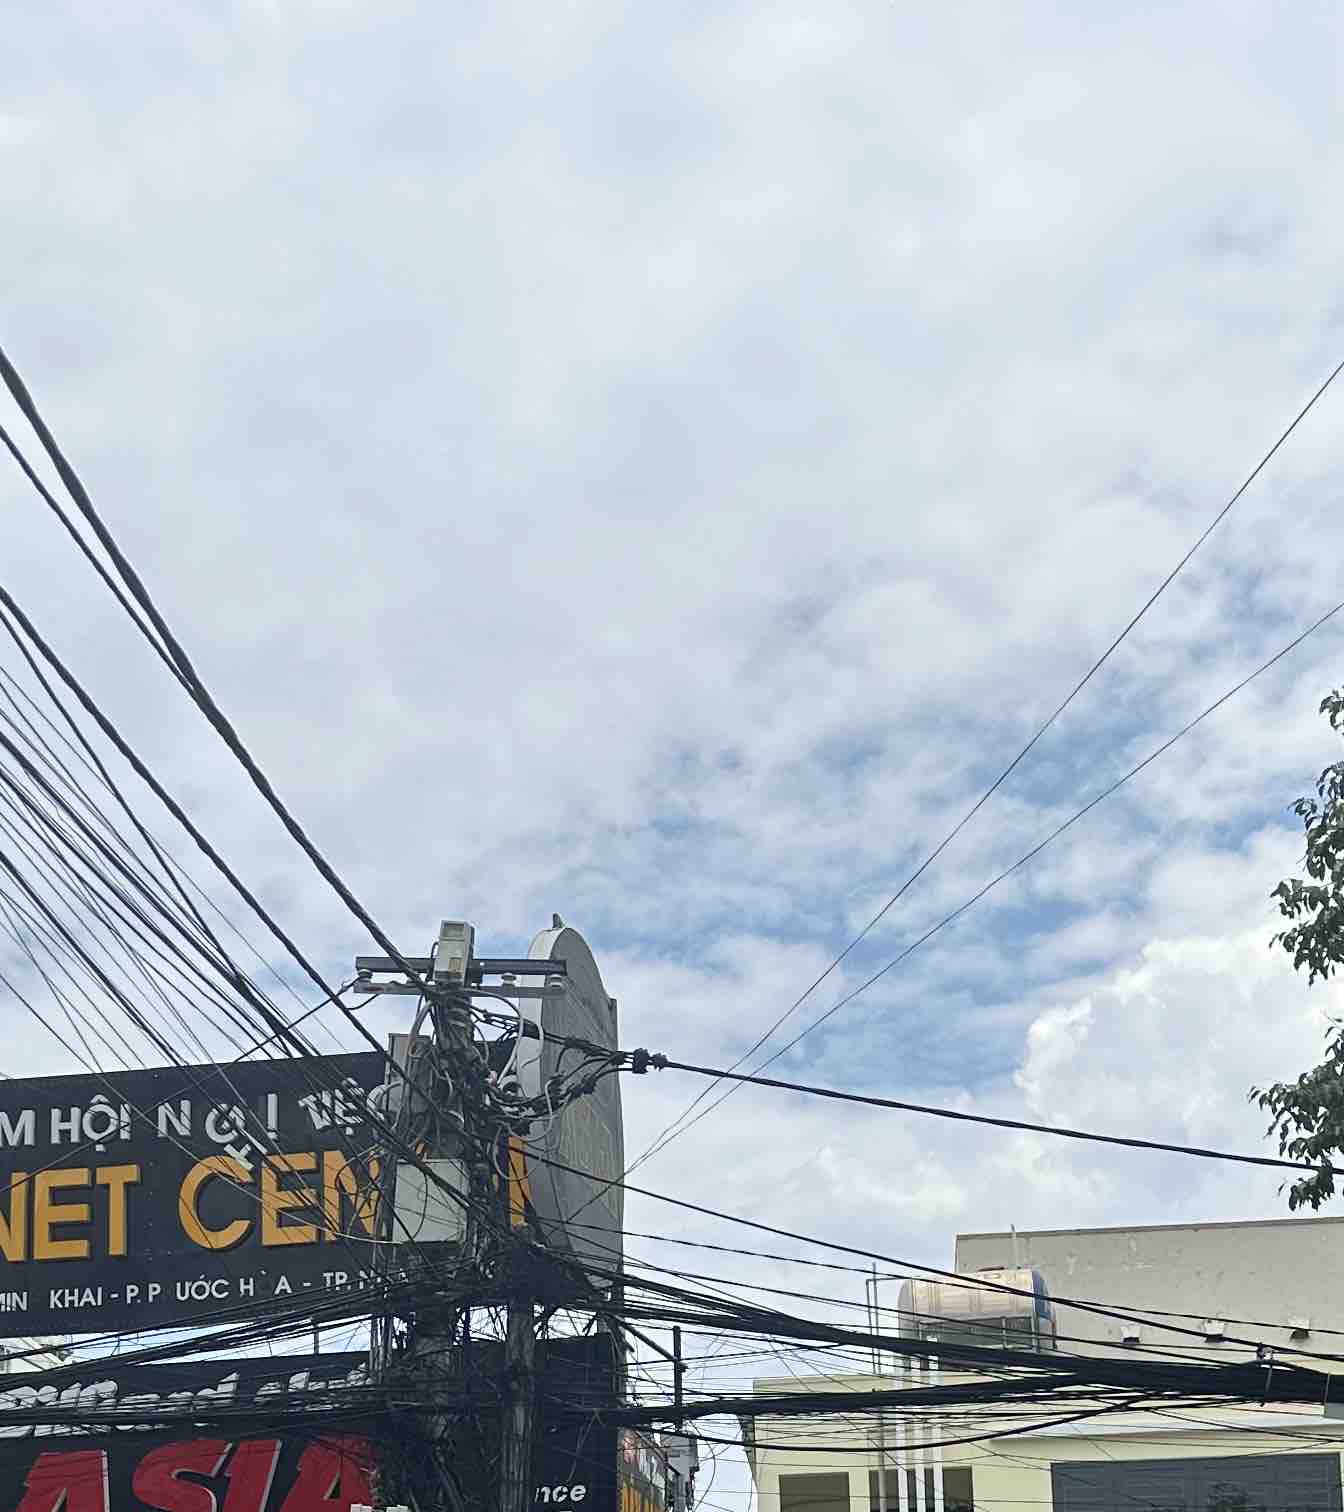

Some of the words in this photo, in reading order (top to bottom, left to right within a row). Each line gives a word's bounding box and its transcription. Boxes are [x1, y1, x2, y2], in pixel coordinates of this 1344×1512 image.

[50, 1094, 132, 1152] HỘI
[49, 1286, 103, 1309] KHAI
[535, 1484, 586, 1504] nce
